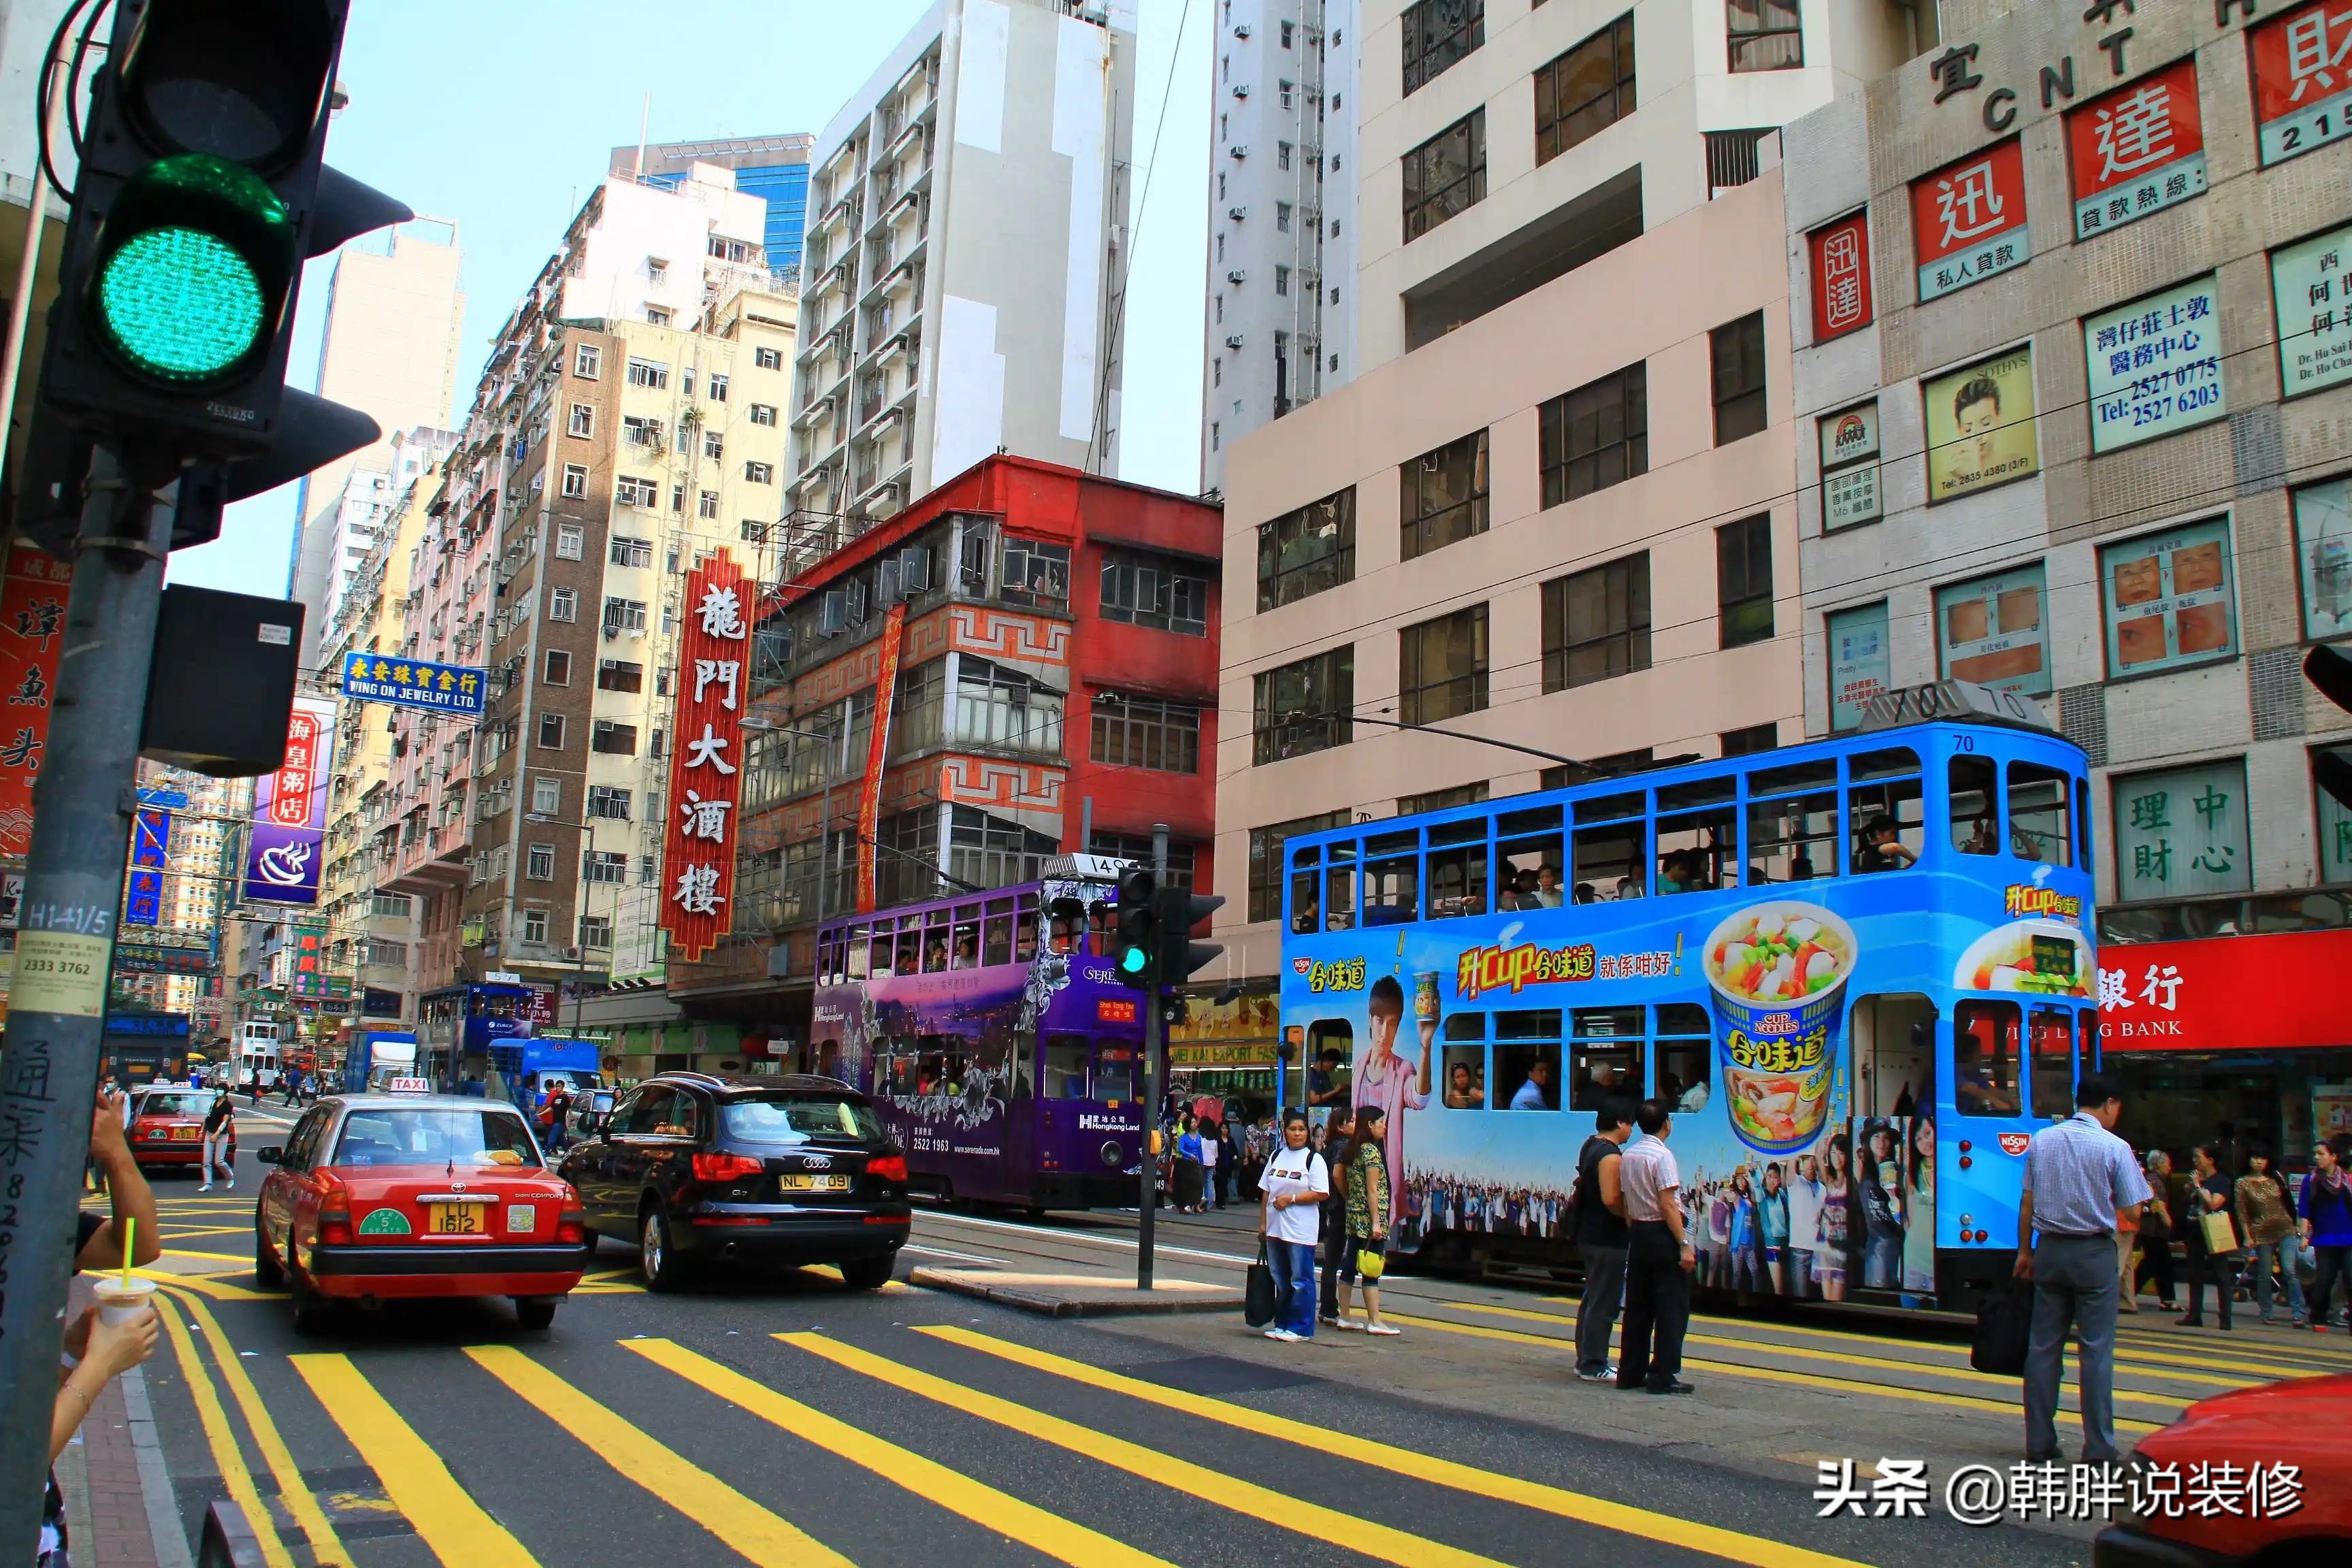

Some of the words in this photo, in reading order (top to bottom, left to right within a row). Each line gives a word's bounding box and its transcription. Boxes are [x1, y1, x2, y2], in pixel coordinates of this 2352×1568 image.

[1827, 233, 1860, 321] 迅達
[1936, 243, 2014, 291] 私人貸款
[2096, 295, 2210, 353] 灣仔莊士敦
[2110, 328, 2200, 376] 醫務中心
[2298, 355, 2313, 365] Dr.
[2330, 343, 2346, 354] Sai
[1976, 355, 2028, 381] SOTHYS
[2131, 372, 2170, 402] 2527
[2175, 355, 2218, 390] 0775
[2300, 369, 2314, 380] Dr.
[2316, 363, 2330, 375] Ho
[2098, 399, 2129, 424] Tel:
[2132, 394, 2174, 429] 2527
[2178, 382, 2219, 414] 6203
[1831, 469, 1873, 491] 面部護理
[1941, 476, 1957, 492] Tel:
[1958, 469, 1982, 486] 2835
[1983, 462, 2007, 480] 4380
[2008, 456, 2029, 475] (3/F)
[349, 681, 377, 694] WING
[381, 685, 395, 697] ON
[399, 687, 451, 704] JEWELRY
[454, 695, 476, 708] LTD.
[1889, 683, 1938, 723] 70
[1978, 687, 2027, 719] 70
[672, 582, 746, 916] 龍門大酒樓
[1953, 735, 1974, 752] 70
[278, 719, 310, 821] 海皇粥店
[29, 903, 110, 934] H141/5
[24, 960, 54, 971] 2333
[58, 961, 90, 975] 3762
[1307, 956, 1367, 993] 合味道
[2097, 964, 2184, 1013] 銀行
[1754, 1021, 1799, 1034] NOODLES
[1764, 1013, 1790, 1024] CUP
[2121, 1020, 2183, 1037] BANK
[546, 1041, 574, 1051] Mobil
[1213, 1046, 1252, 1062] EXPORT
[1727, 1024, 1827, 1073] 合味道
[395, 1077, 427, 1090] TAXI
[1092, 1123, 1124, 1131] Hongkong
[913, 1138, 930, 1150] 2522
[932, 1139, 949, 1152] 1963
[2002, 1135, 2027, 1147] NISSIN
[783, 1176, 802, 1188] NL
[808, 1175, 846, 1188] 7409
[372, 1210, 398, 1220] TAXI
[381, 1217, 389, 1226] 5
[446, 1203, 468, 1218] LU
[439, 1218, 474, 1232] 1612
